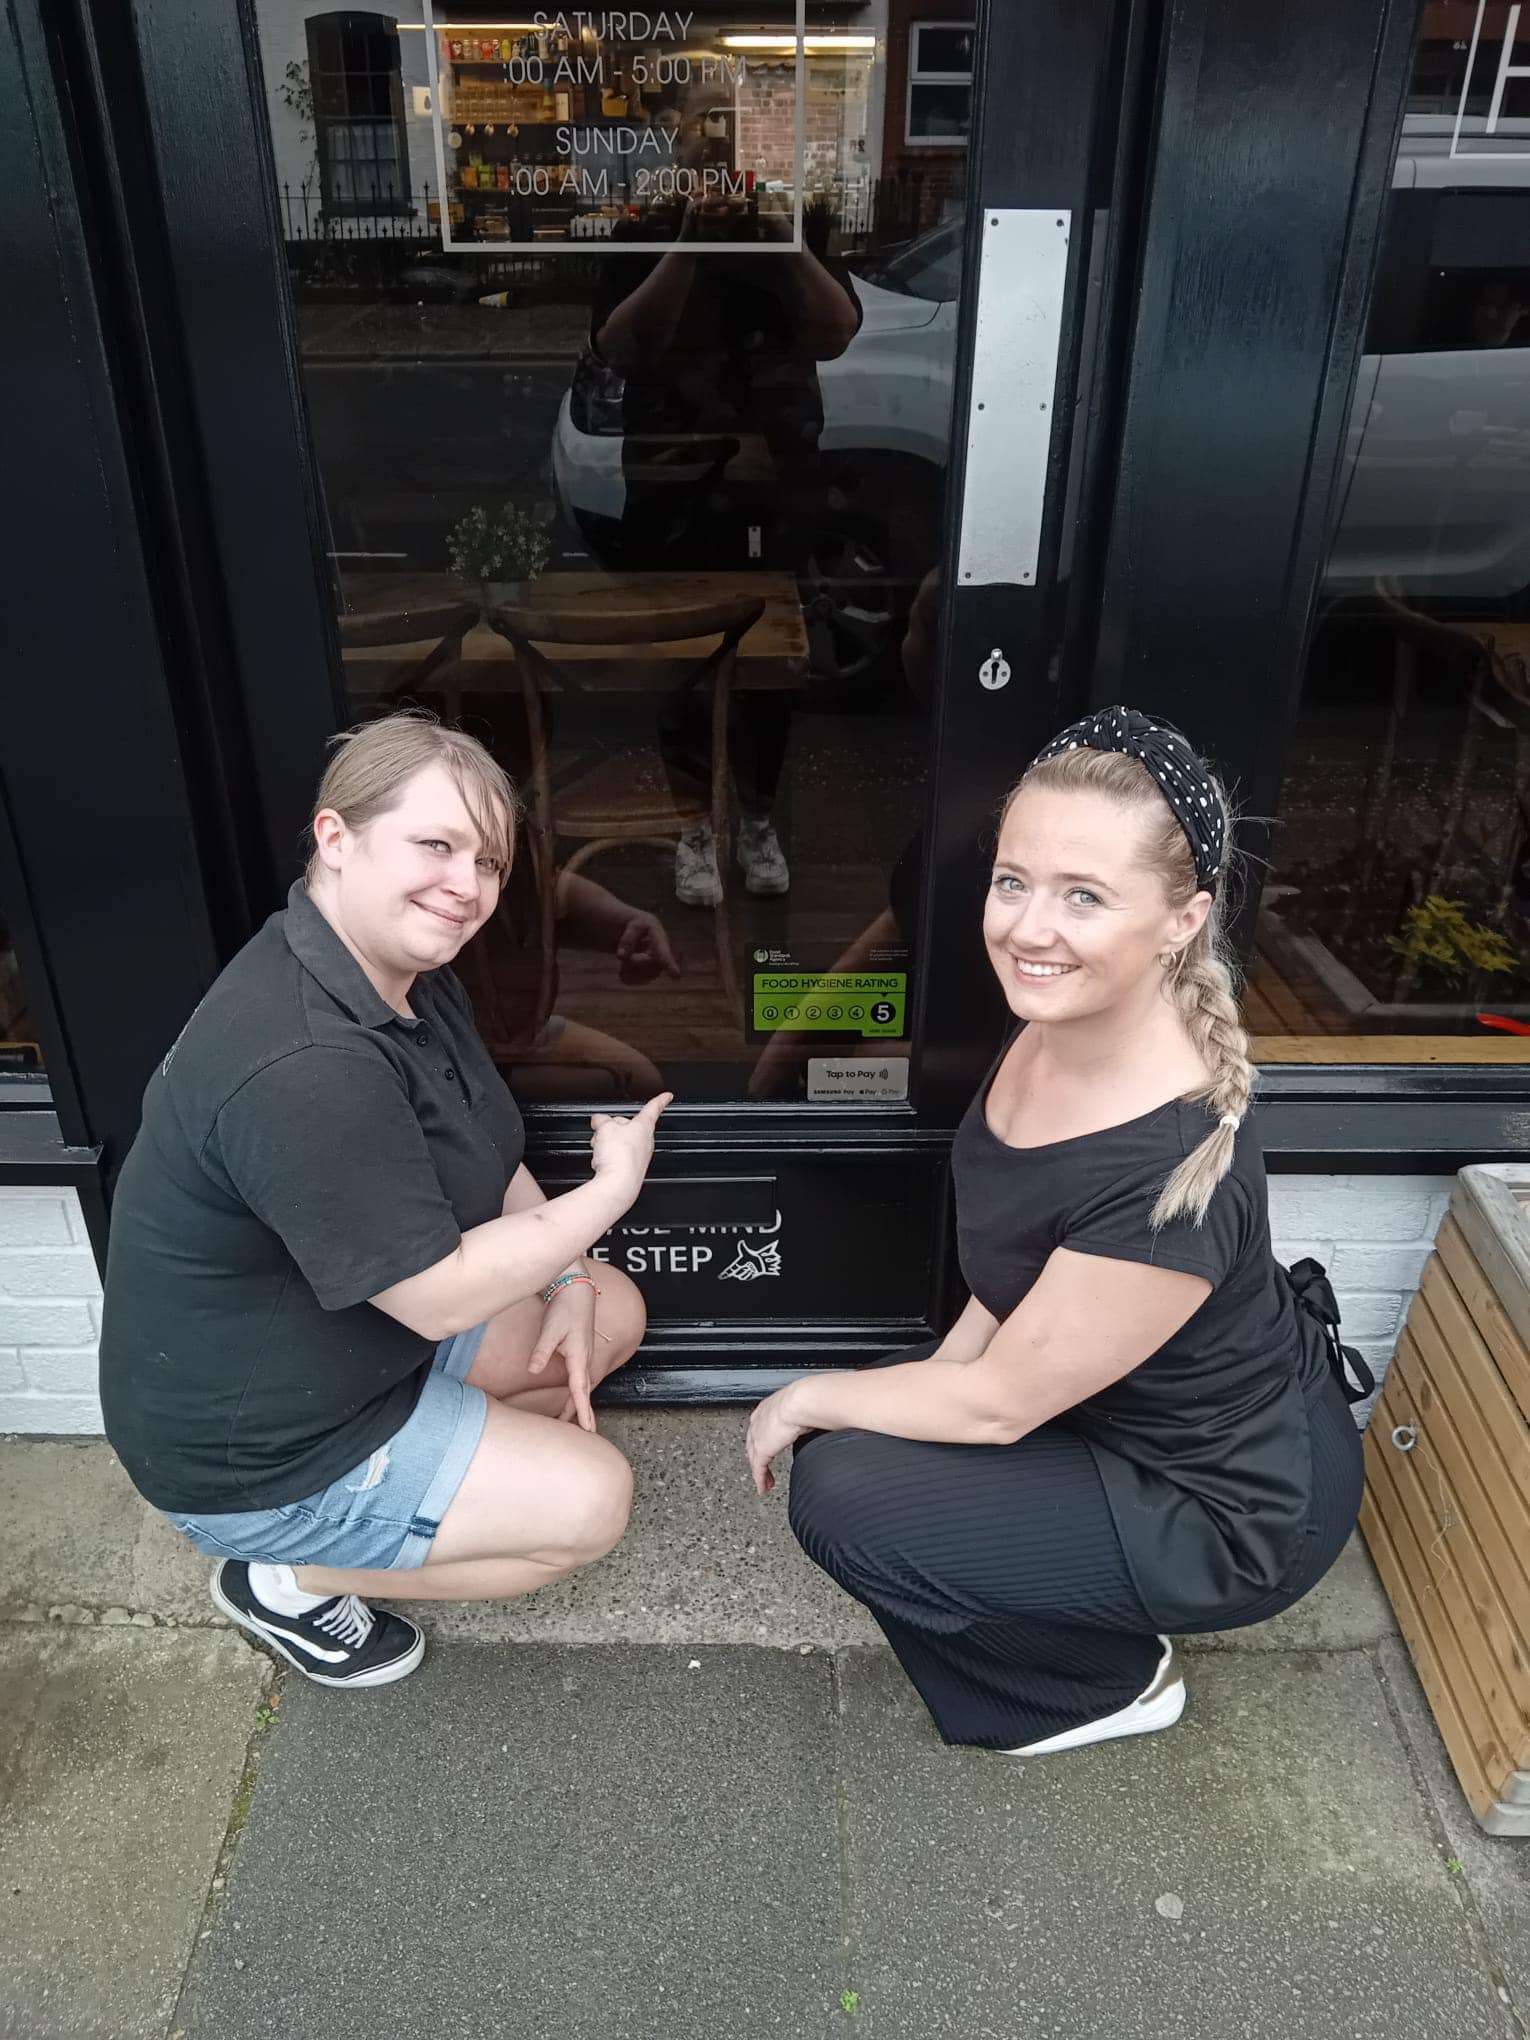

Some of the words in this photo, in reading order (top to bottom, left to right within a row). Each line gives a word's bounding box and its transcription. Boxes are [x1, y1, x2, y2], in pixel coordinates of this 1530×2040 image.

[533, 11, 694, 41] SATURDAY
[553, 56, 604, 84] AM
[631, 56, 690, 84] 5:00
[702, 55, 747, 84] PM
[556, 127, 679, 155] SUNDAY
[560, 168, 608, 197] AM
[634, 168, 694, 197] 2:00
[703, 168, 747, 197] PM
[762, 979, 799, 988] FOOD
[801, 979, 853, 988] HYGIENE
[855, 979, 898, 988] RATING
[876, 1004, 890, 1021] 5
[826, 1070, 844, 1080] Tap
[846, 1070, 855, 1078] to
[857, 1070, 876, 1080] Pay
[626, 1246, 713, 1273] STEP
